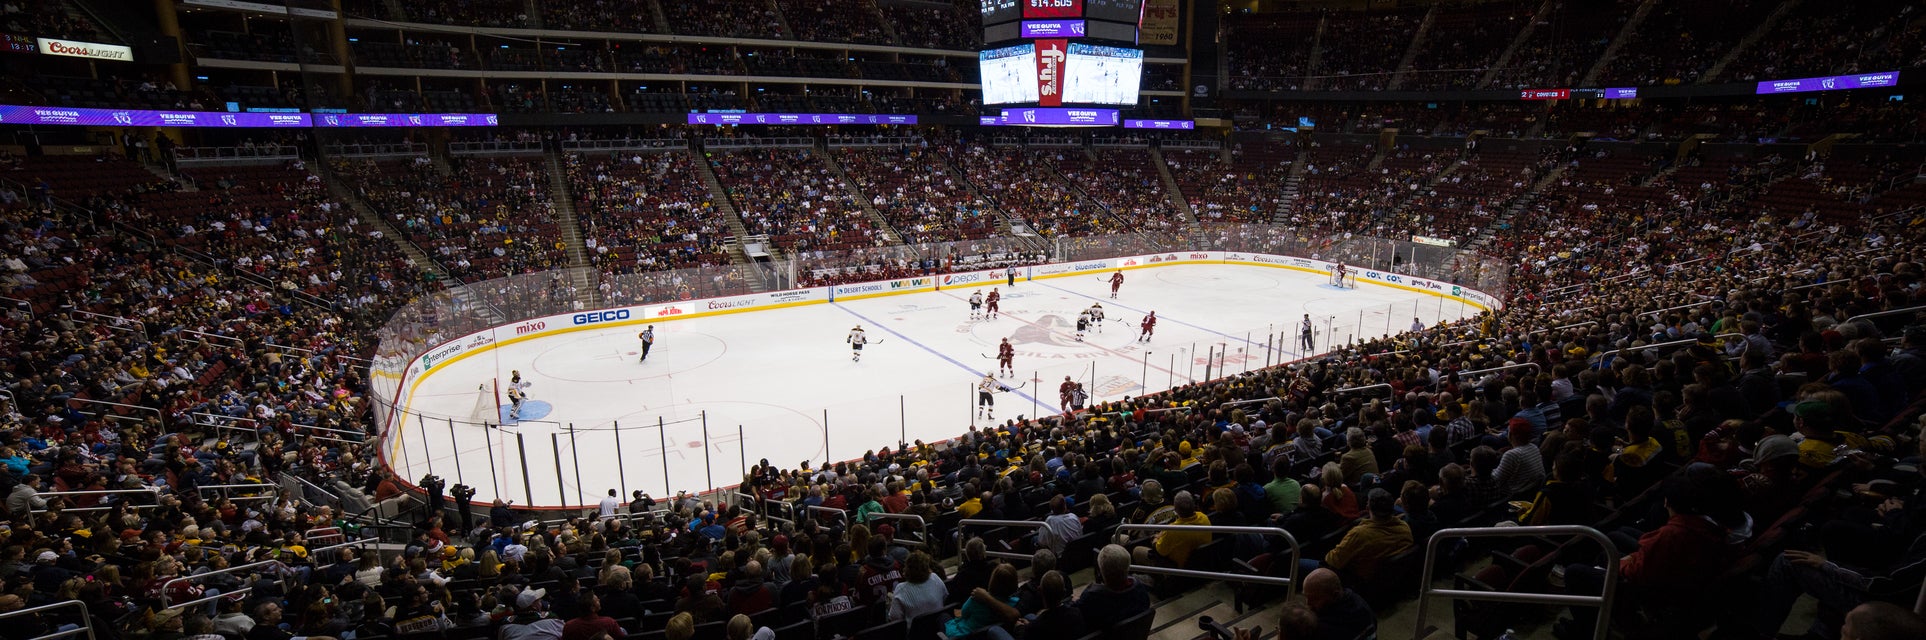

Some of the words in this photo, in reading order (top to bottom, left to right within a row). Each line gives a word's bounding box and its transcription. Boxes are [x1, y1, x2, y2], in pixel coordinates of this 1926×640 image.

[48, 42, 89, 55] Coors
[88, 50, 124, 58] LIGHT
[891, 280, 911, 288] WM
[954, 272, 979, 284] pepsi
[708, 301, 732, 309] Coors
[573, 309, 630, 325] GEICO
[516, 321, 546, 334] mix1
[424, 344, 461, 366] enterprise
[868, 570, 902, 586] CHIPCHURA
